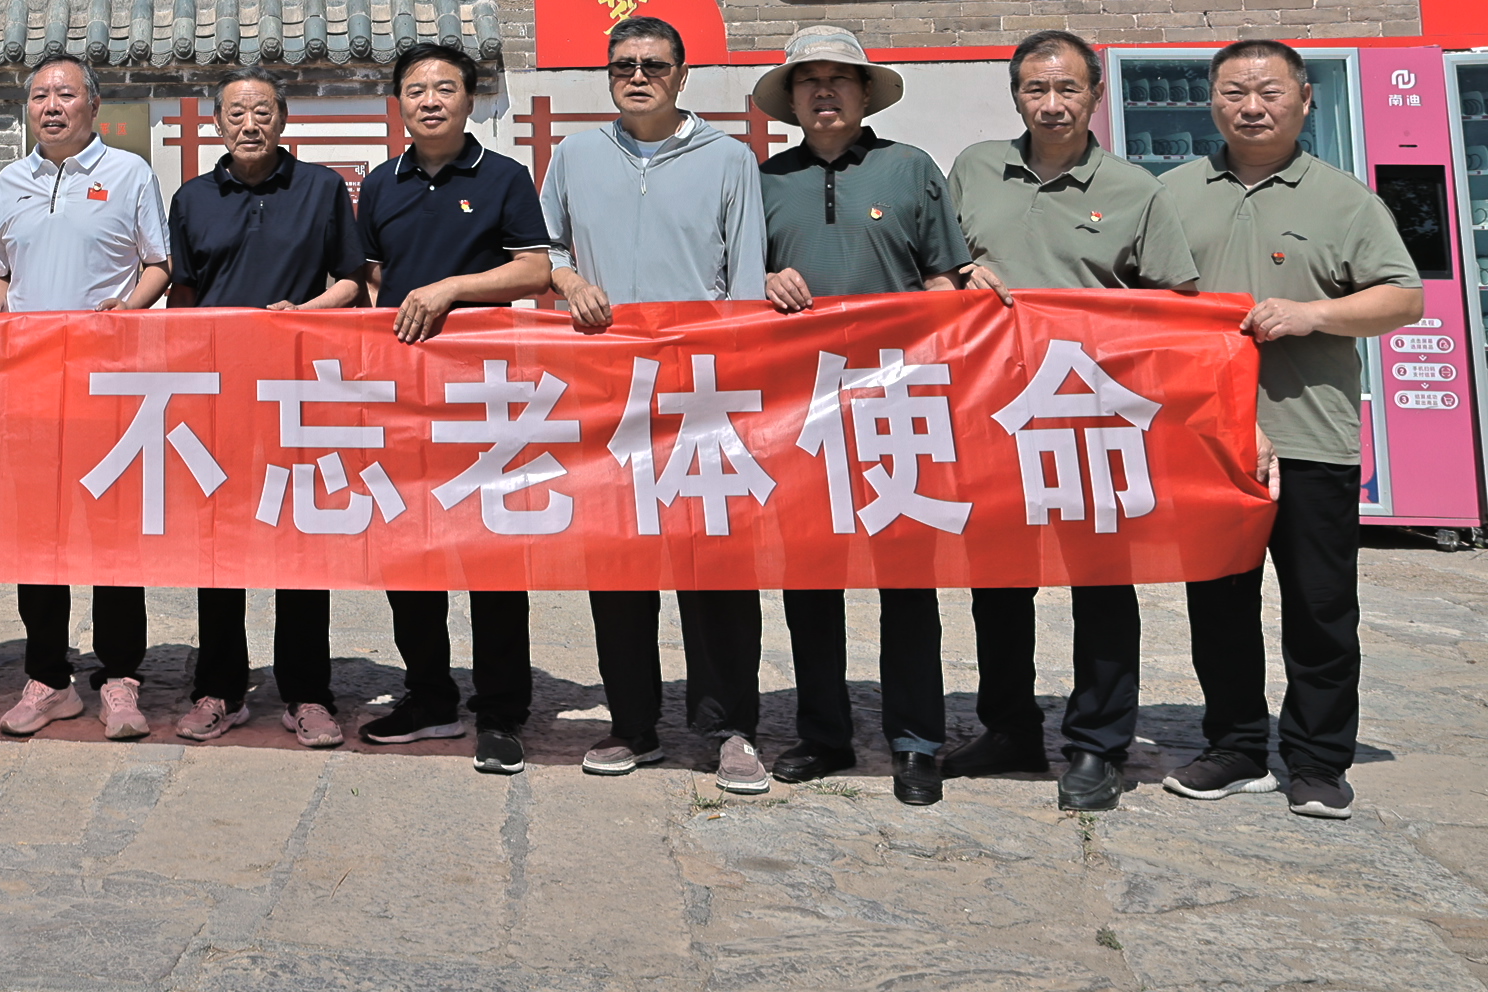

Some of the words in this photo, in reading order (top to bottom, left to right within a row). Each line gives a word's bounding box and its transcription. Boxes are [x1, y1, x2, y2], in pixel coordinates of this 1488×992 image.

[1388, 94, 1422, 107] 南迪
[79, 338, 1163, 536] 不忘老体使命
